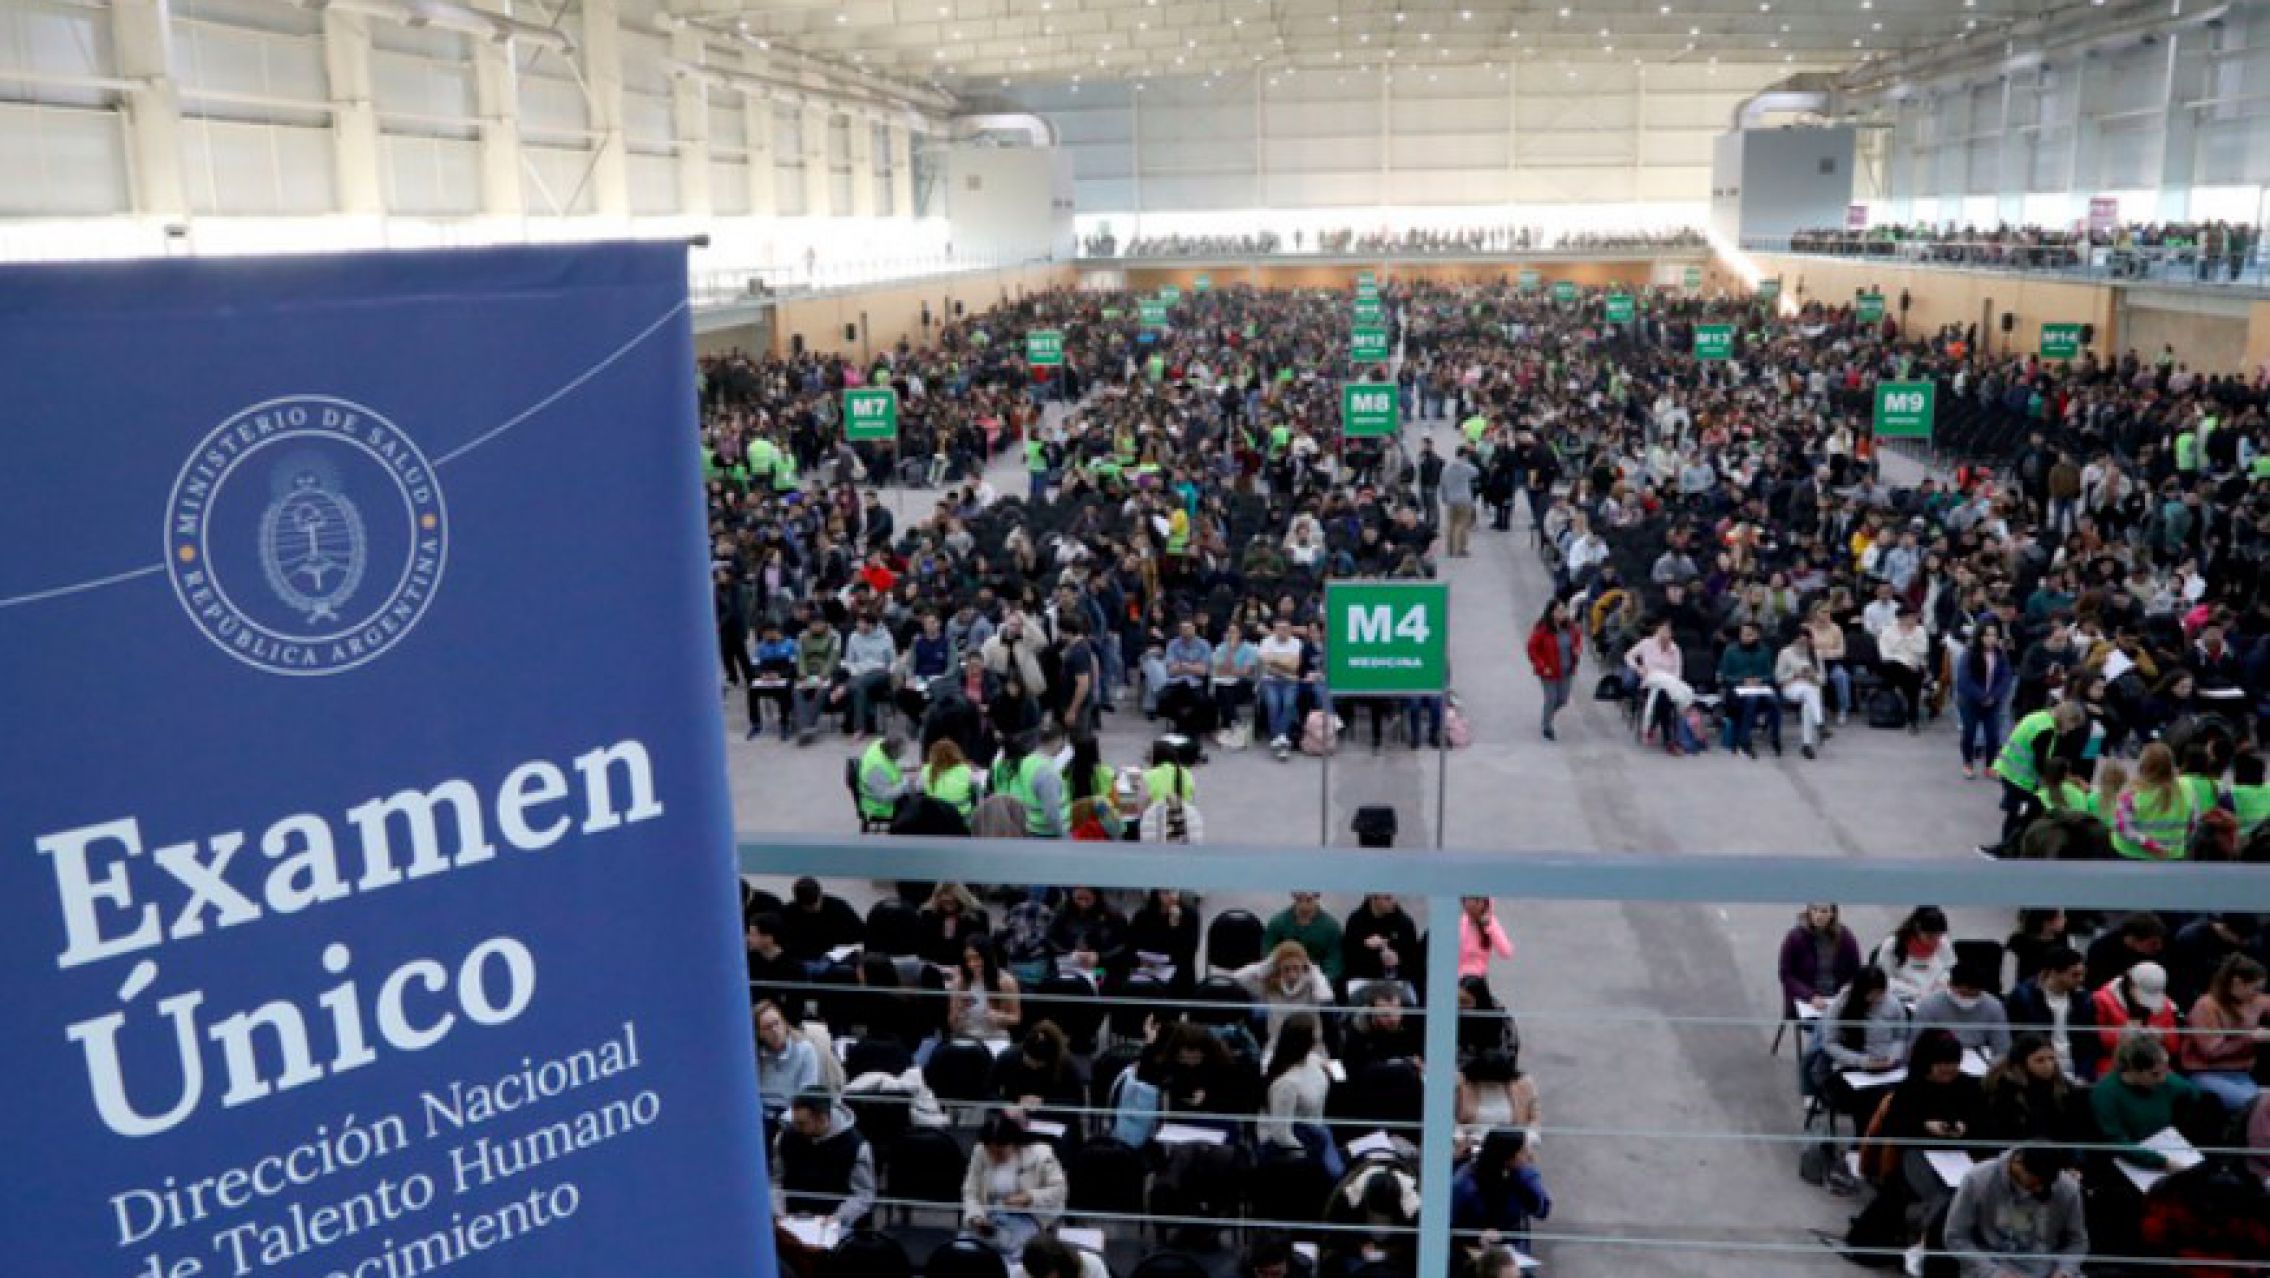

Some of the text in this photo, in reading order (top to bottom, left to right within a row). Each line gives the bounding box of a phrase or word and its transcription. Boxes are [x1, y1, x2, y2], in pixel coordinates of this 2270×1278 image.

[853, 398, 887, 417] M7
[1351, 392, 1390, 412] M8
[1884, 391, 1925, 413] M9
[177, 406, 432, 535] MINISTERIO DE SALUD
[332, 537, 438, 663] ARGENTINA
[1347, 603, 1430, 643] M4
[36, 740, 663, 969] Examen
[66, 936, 536, 1137] Único
[110, 1021, 641, 1246] Dirección Nacional
[213, 1173, 434, 1276] Talento
[449, 1091, 661, 1194] Humano
